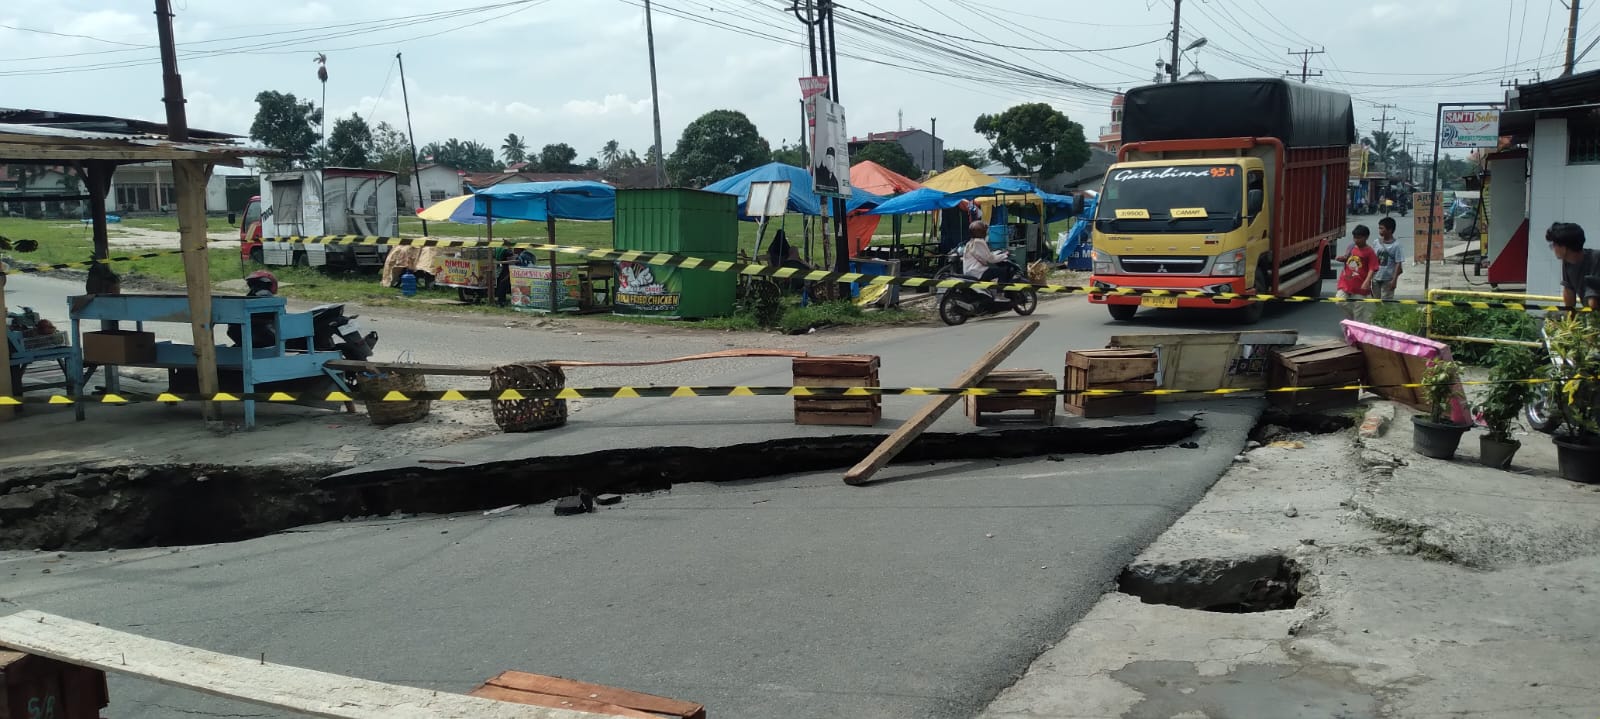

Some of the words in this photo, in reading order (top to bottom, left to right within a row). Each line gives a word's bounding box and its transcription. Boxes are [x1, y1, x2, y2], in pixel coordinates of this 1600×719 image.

[1446, 112, 1473, 123] SANTI
[1114, 167, 1210, 181] Gatubima
[1209, 166, 1235, 177] 95.1
[630, 295, 648, 305] FRIED
[648, 295, 679, 305] CHICKEN
